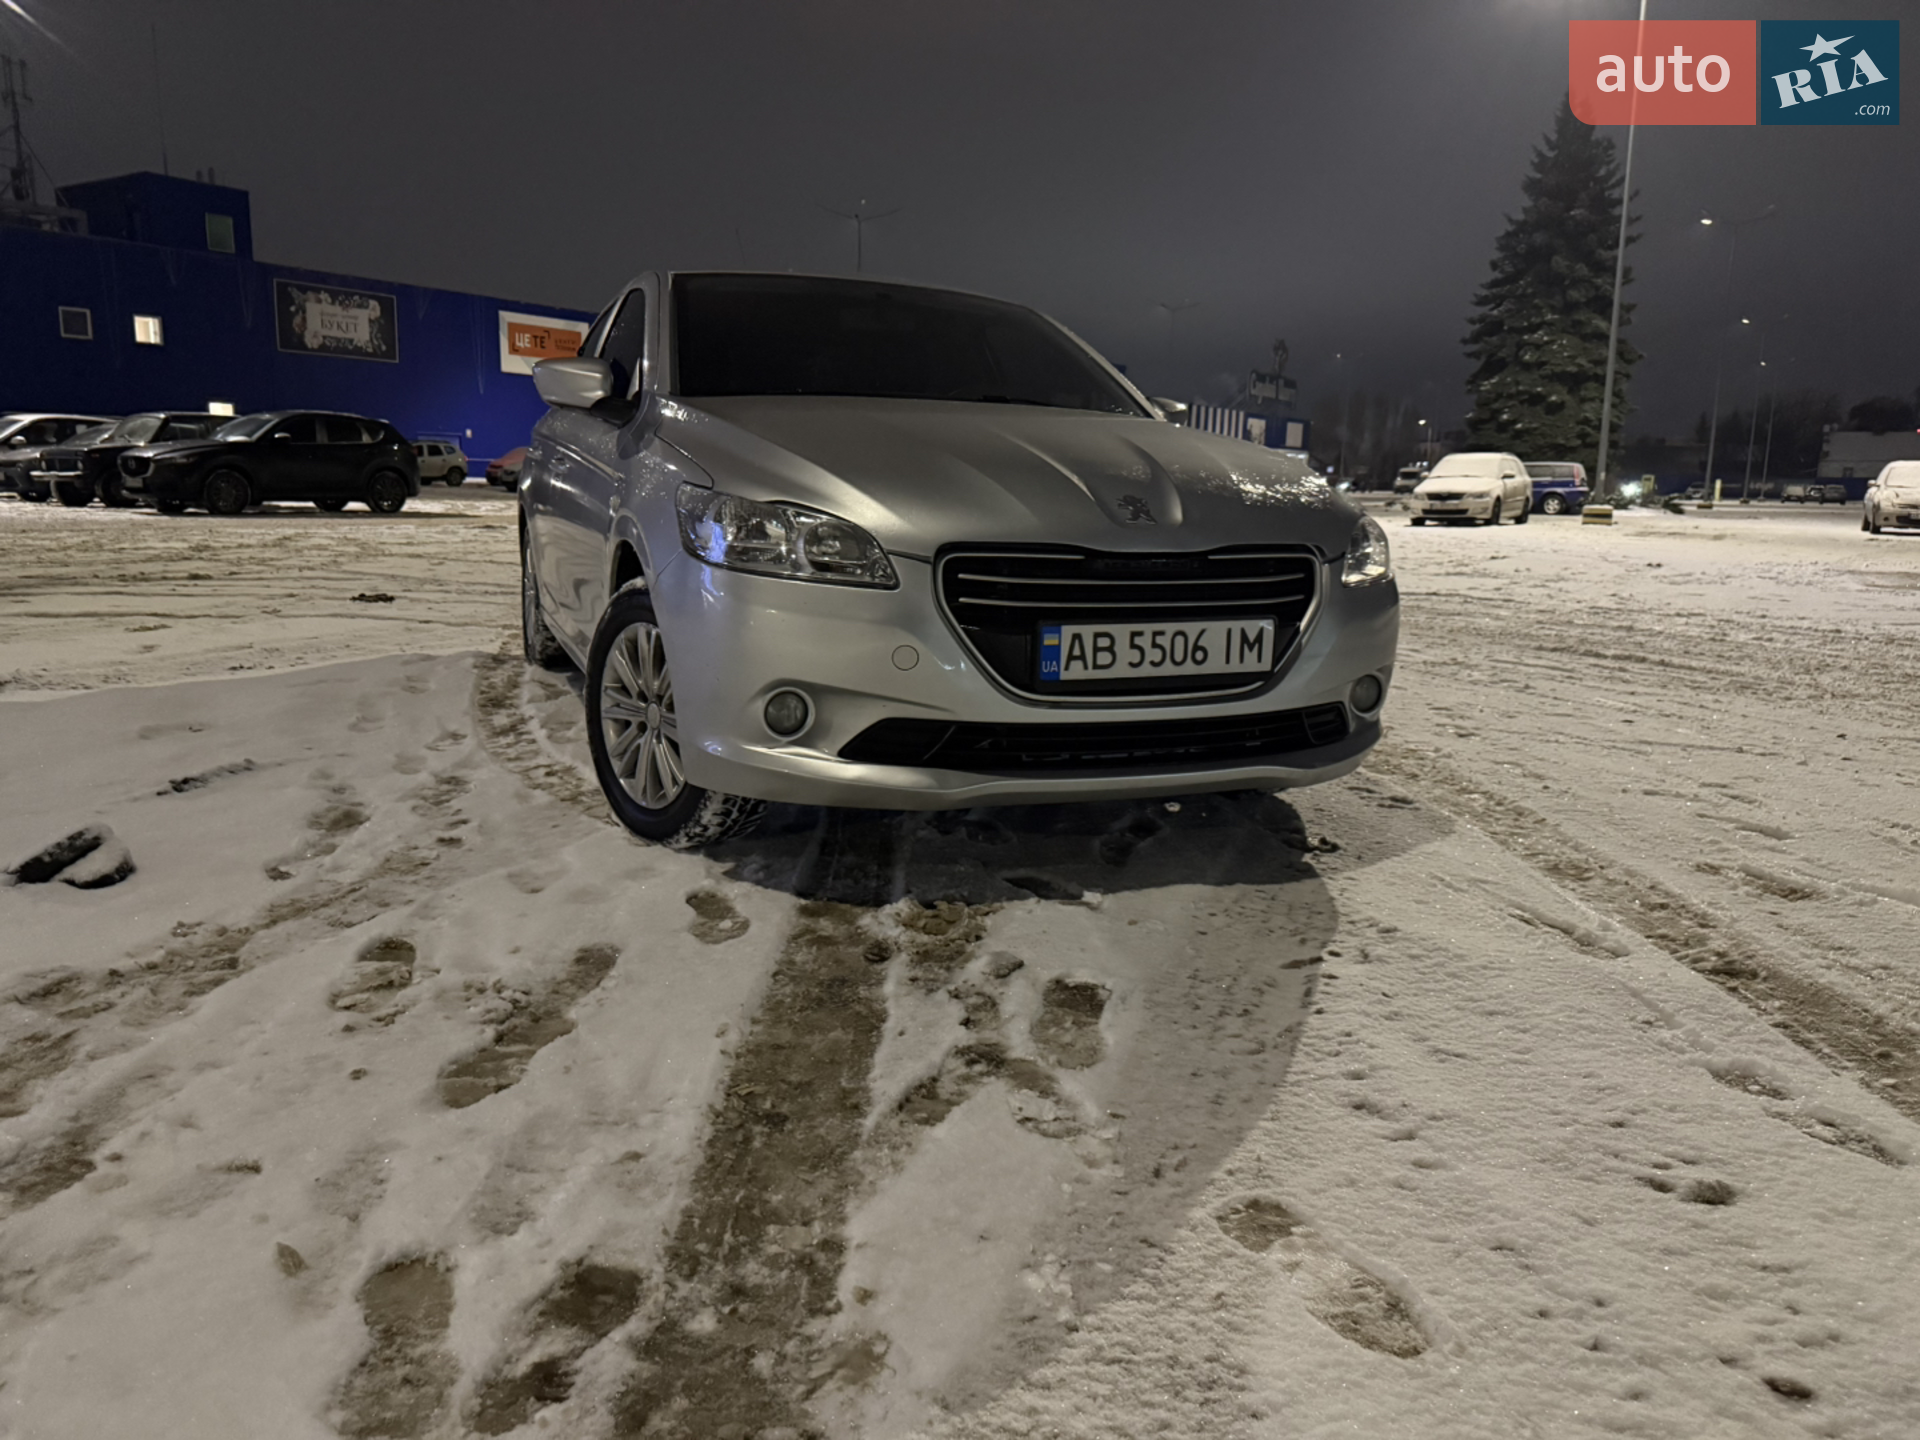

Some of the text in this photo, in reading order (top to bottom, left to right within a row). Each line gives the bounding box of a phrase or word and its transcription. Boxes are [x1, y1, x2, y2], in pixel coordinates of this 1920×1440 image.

[1063, 626, 1265, 672] AB 5506 IM
[1042, 660, 1059, 673] UA
